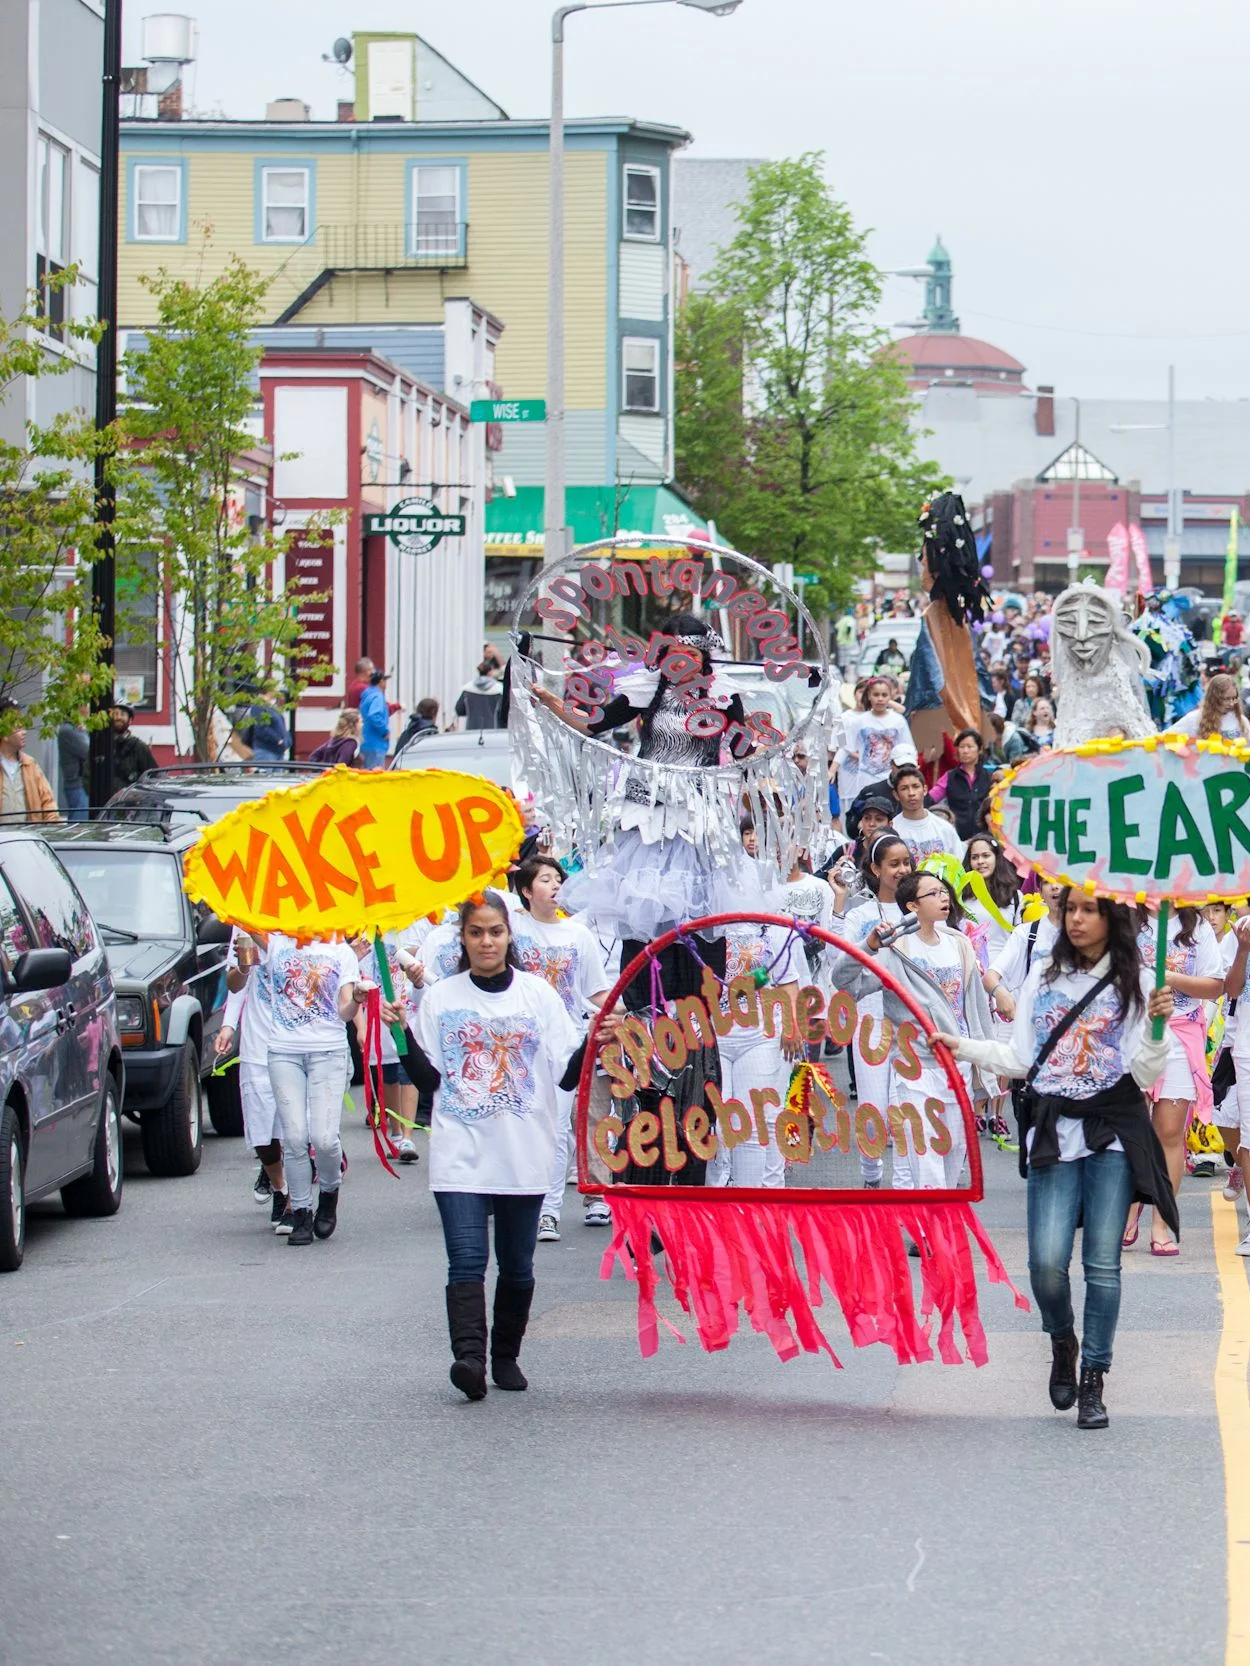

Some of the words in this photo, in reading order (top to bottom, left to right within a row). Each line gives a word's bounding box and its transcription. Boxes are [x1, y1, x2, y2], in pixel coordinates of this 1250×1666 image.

[493, 403, 520, 420] WISE
[370, 517, 462, 533] LIQUOR
[534, 555, 812, 683] spontaneous
[201, 803, 397, 919] WAKE
[410, 796, 503, 883] UP
[1009, 784, 1096, 865] THE
[599, 965, 923, 1100] spontaneous
[594, 1082, 952, 1173] celebrations
